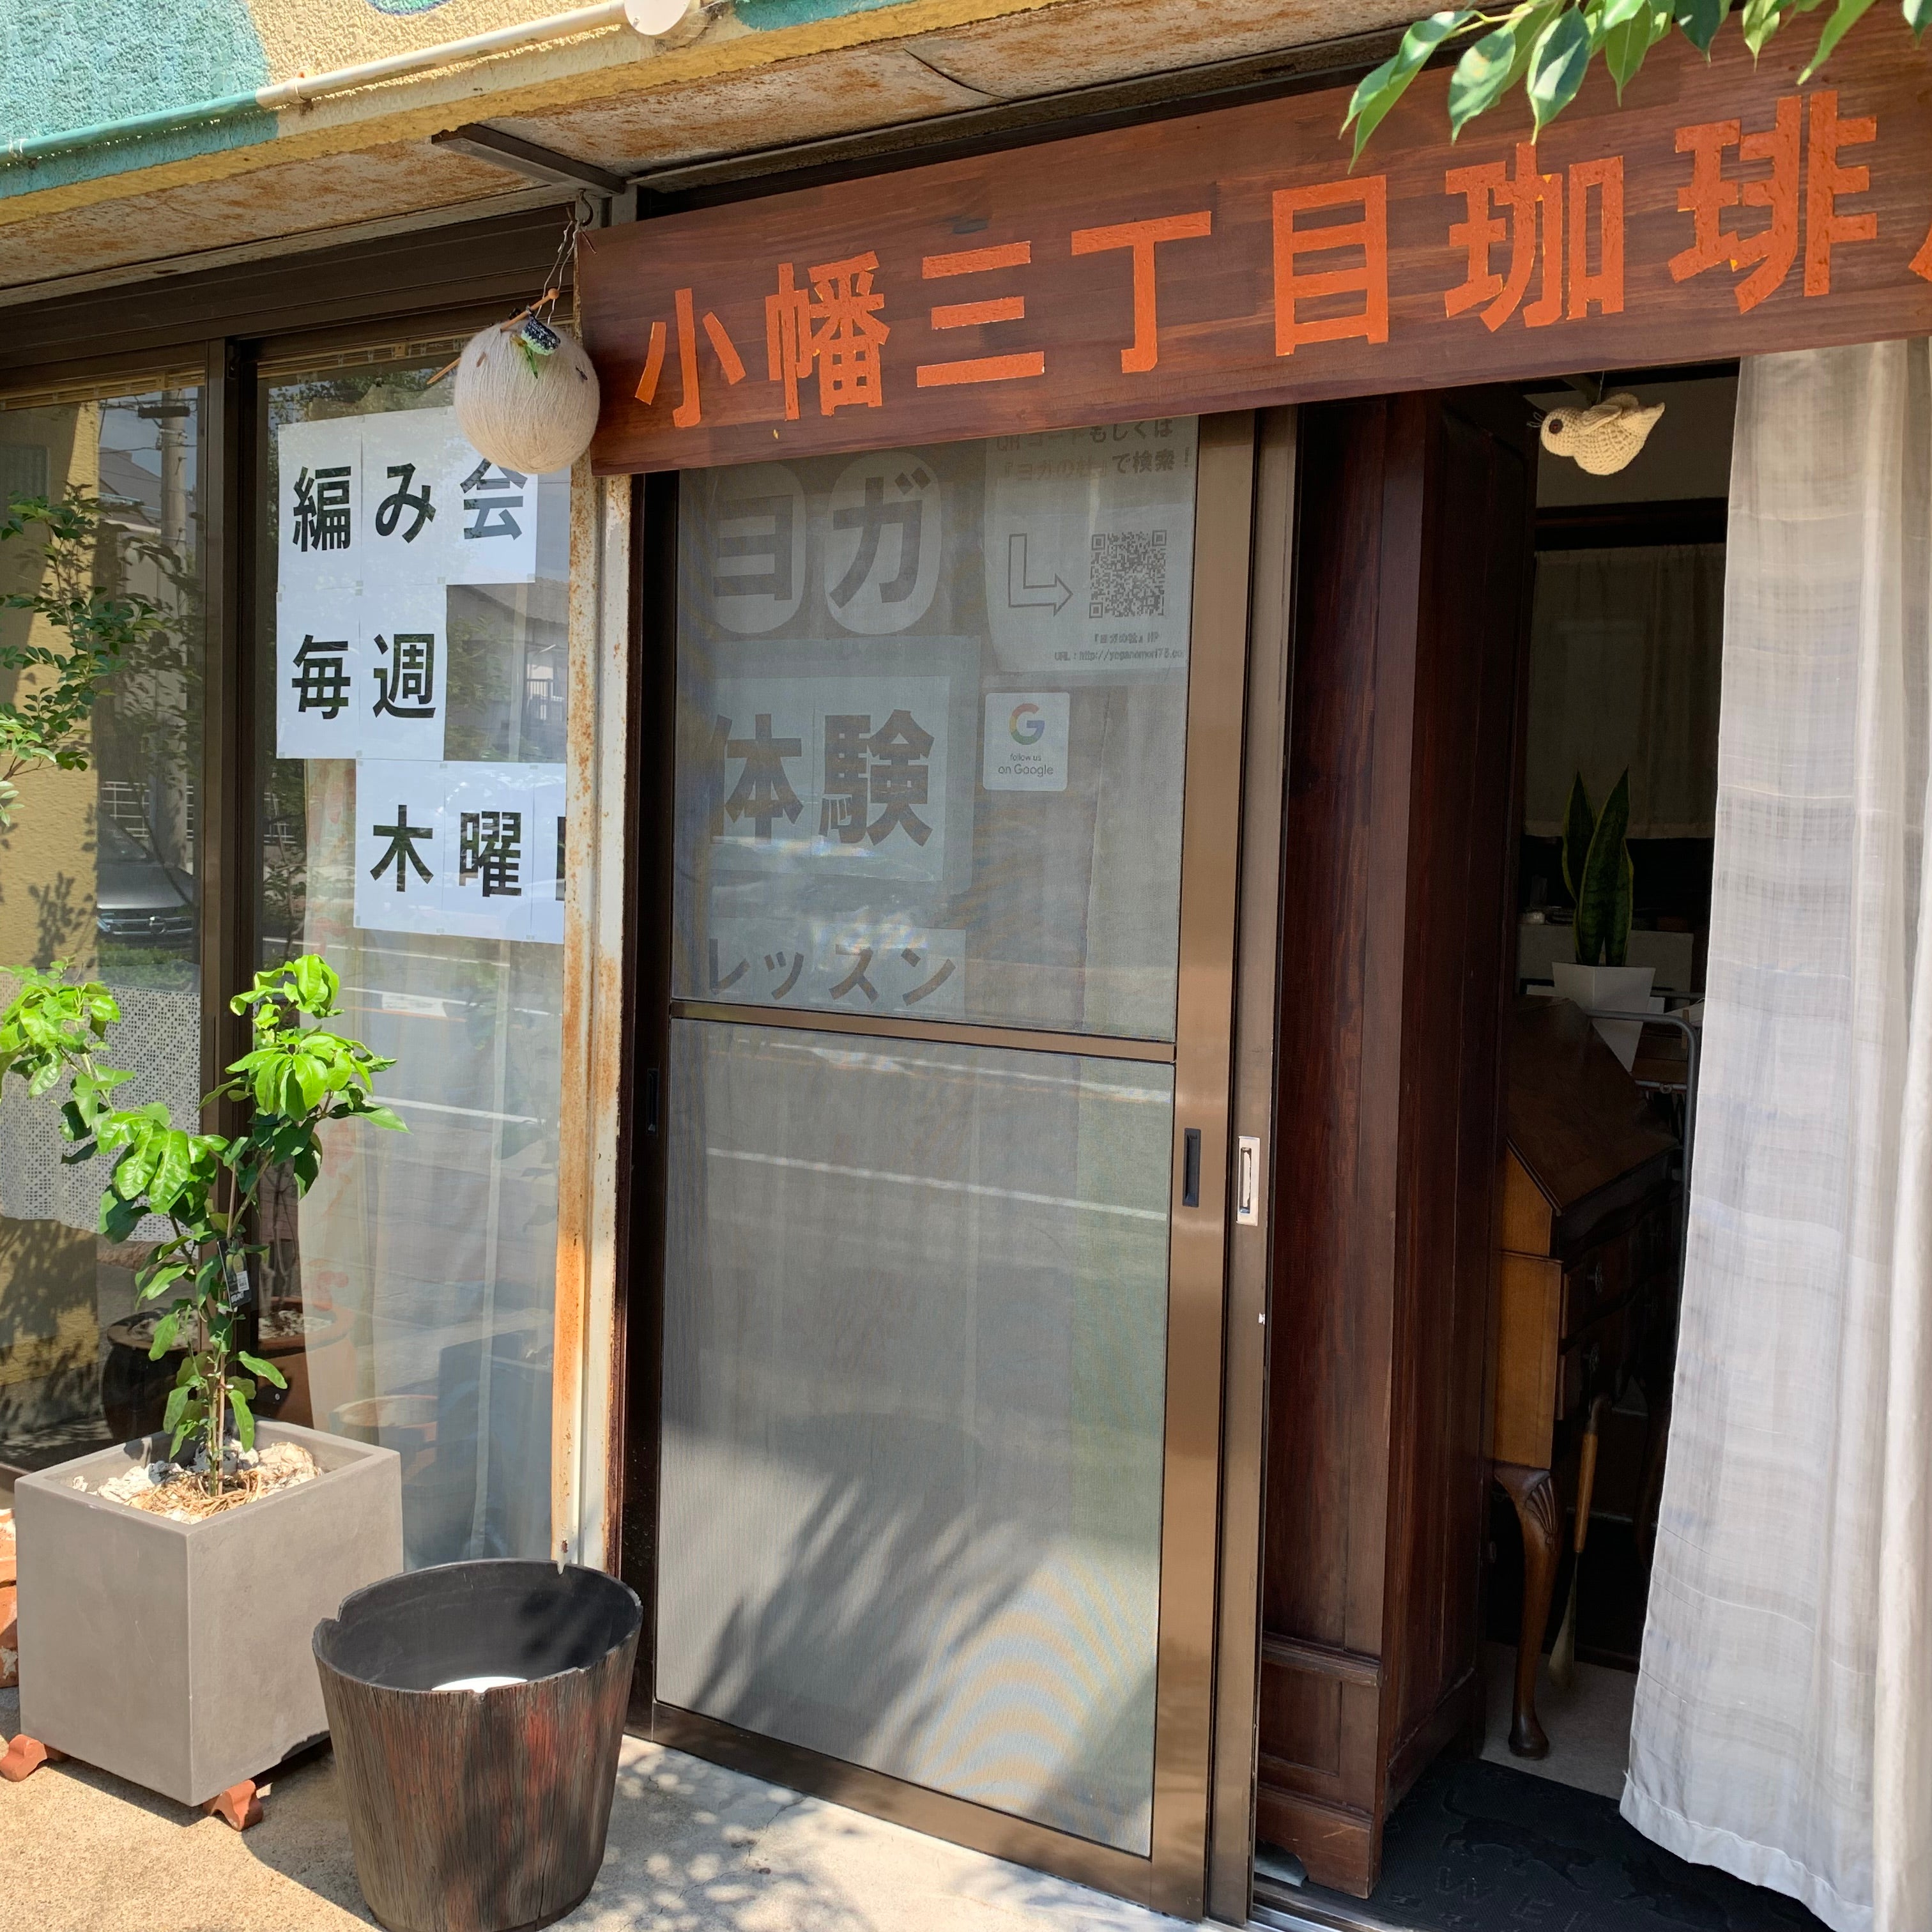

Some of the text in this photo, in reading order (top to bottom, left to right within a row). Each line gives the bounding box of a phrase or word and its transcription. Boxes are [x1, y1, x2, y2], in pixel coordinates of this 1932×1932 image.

[634, 90, 1932, 429] 小幡三丁目珈琲
[292, 457, 528, 552] 編み会
[714, 466, 931, 609] ヨガ
[291, 633, 436, 719] 毎週
[710, 709, 935, 847] 体験
[998, 763, 1054, 778] on Google
[1010, 753, 1031, 761] follow
[370, 804, 565, 901] 木曜
[709, 938, 956, 1007] レッスン
